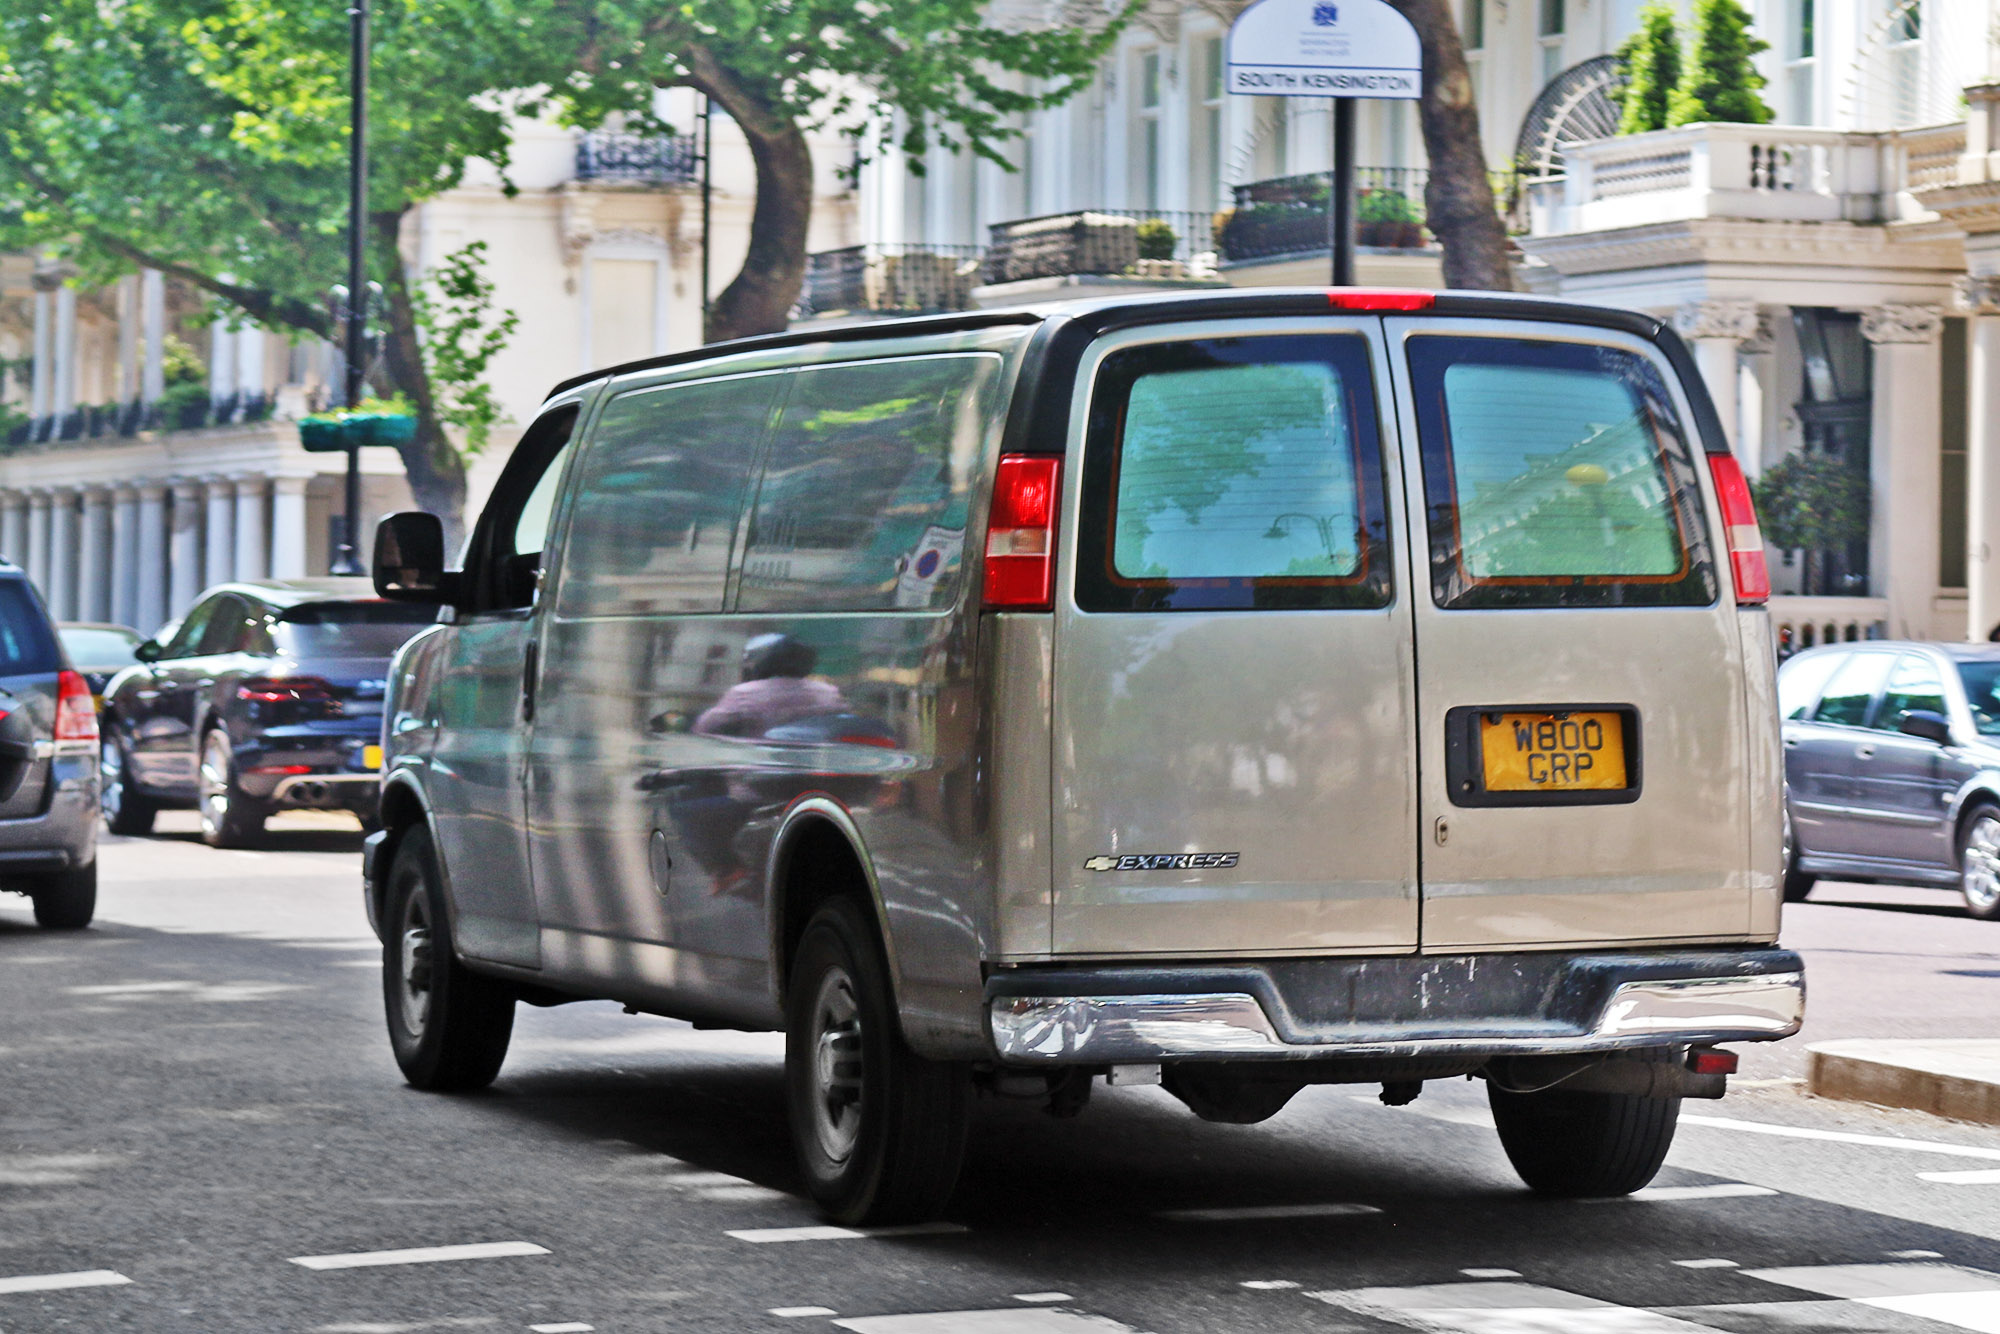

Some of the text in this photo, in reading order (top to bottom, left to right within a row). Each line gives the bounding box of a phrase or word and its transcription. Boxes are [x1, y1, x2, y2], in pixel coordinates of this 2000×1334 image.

[1238, 72, 1412, 91] SOUTH KENSINGTON
[1515, 720, 1603, 751] W800
[1527, 753, 1594, 783] GRP
[1115, 852, 1240, 870] EXPRESS
